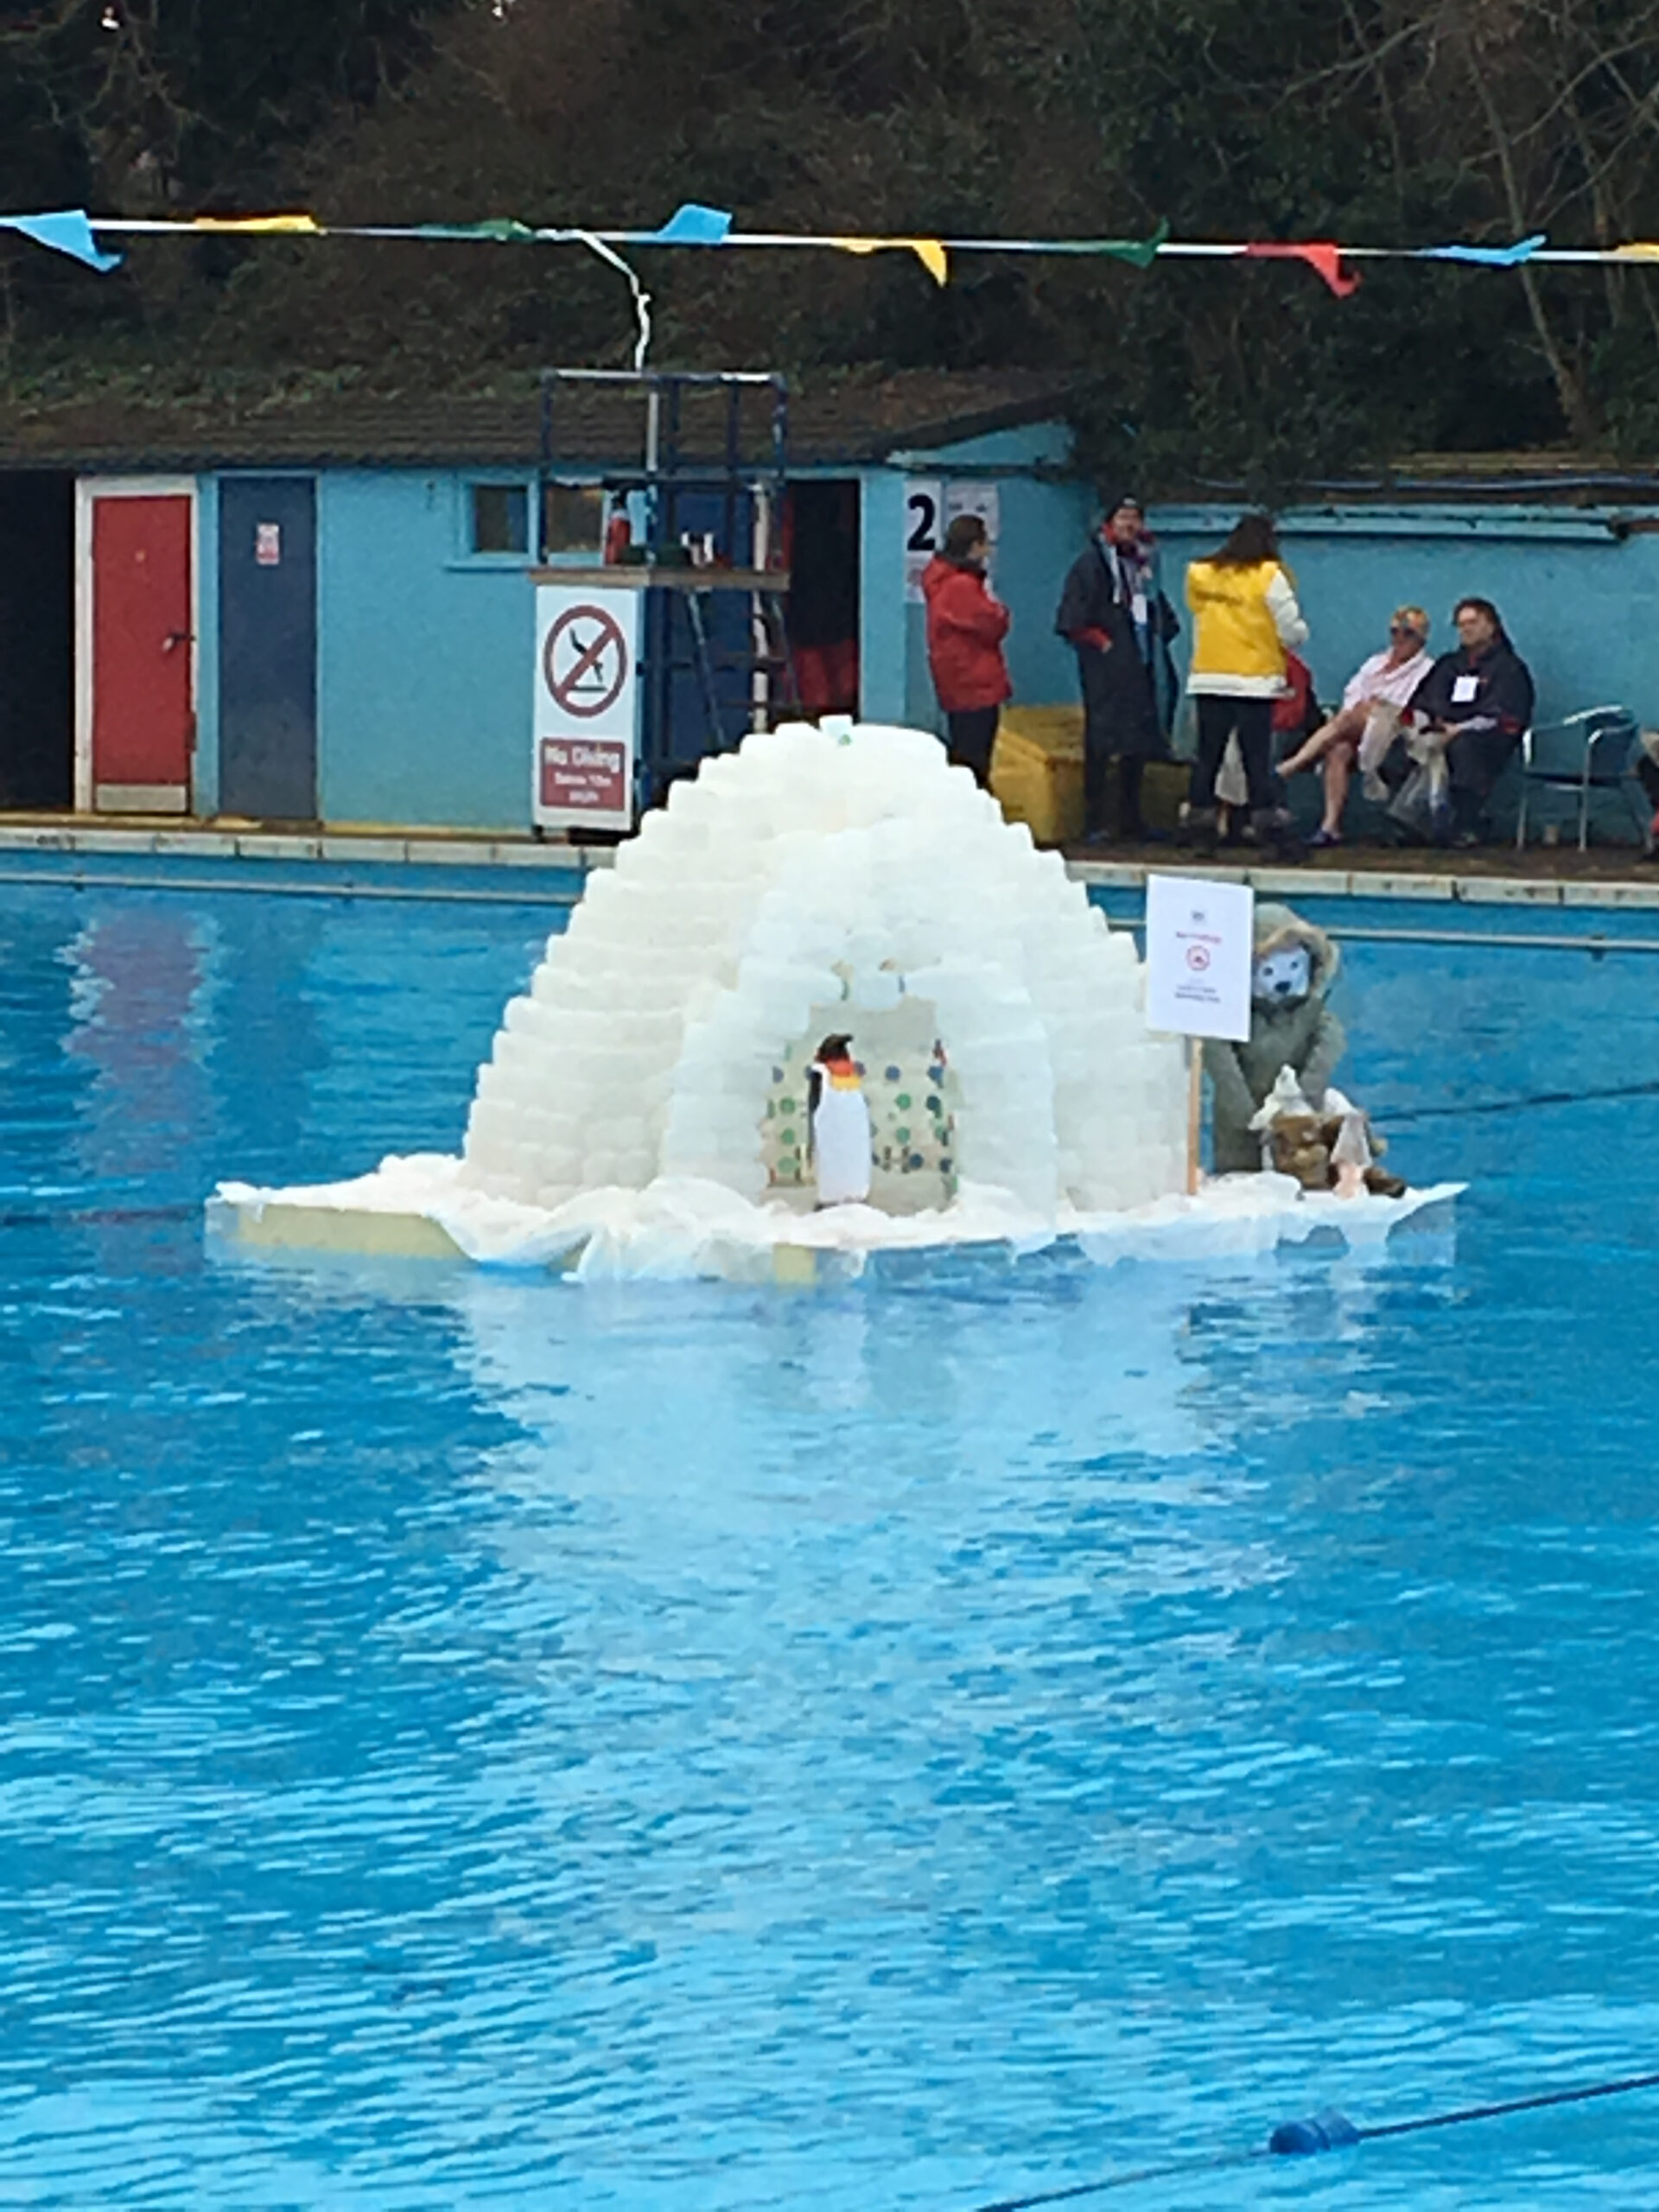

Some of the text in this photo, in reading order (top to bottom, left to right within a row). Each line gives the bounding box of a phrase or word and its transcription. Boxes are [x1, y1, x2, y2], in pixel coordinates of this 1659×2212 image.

[906, 493, 936, 551] 2
[544, 744, 620, 773] No Diving
